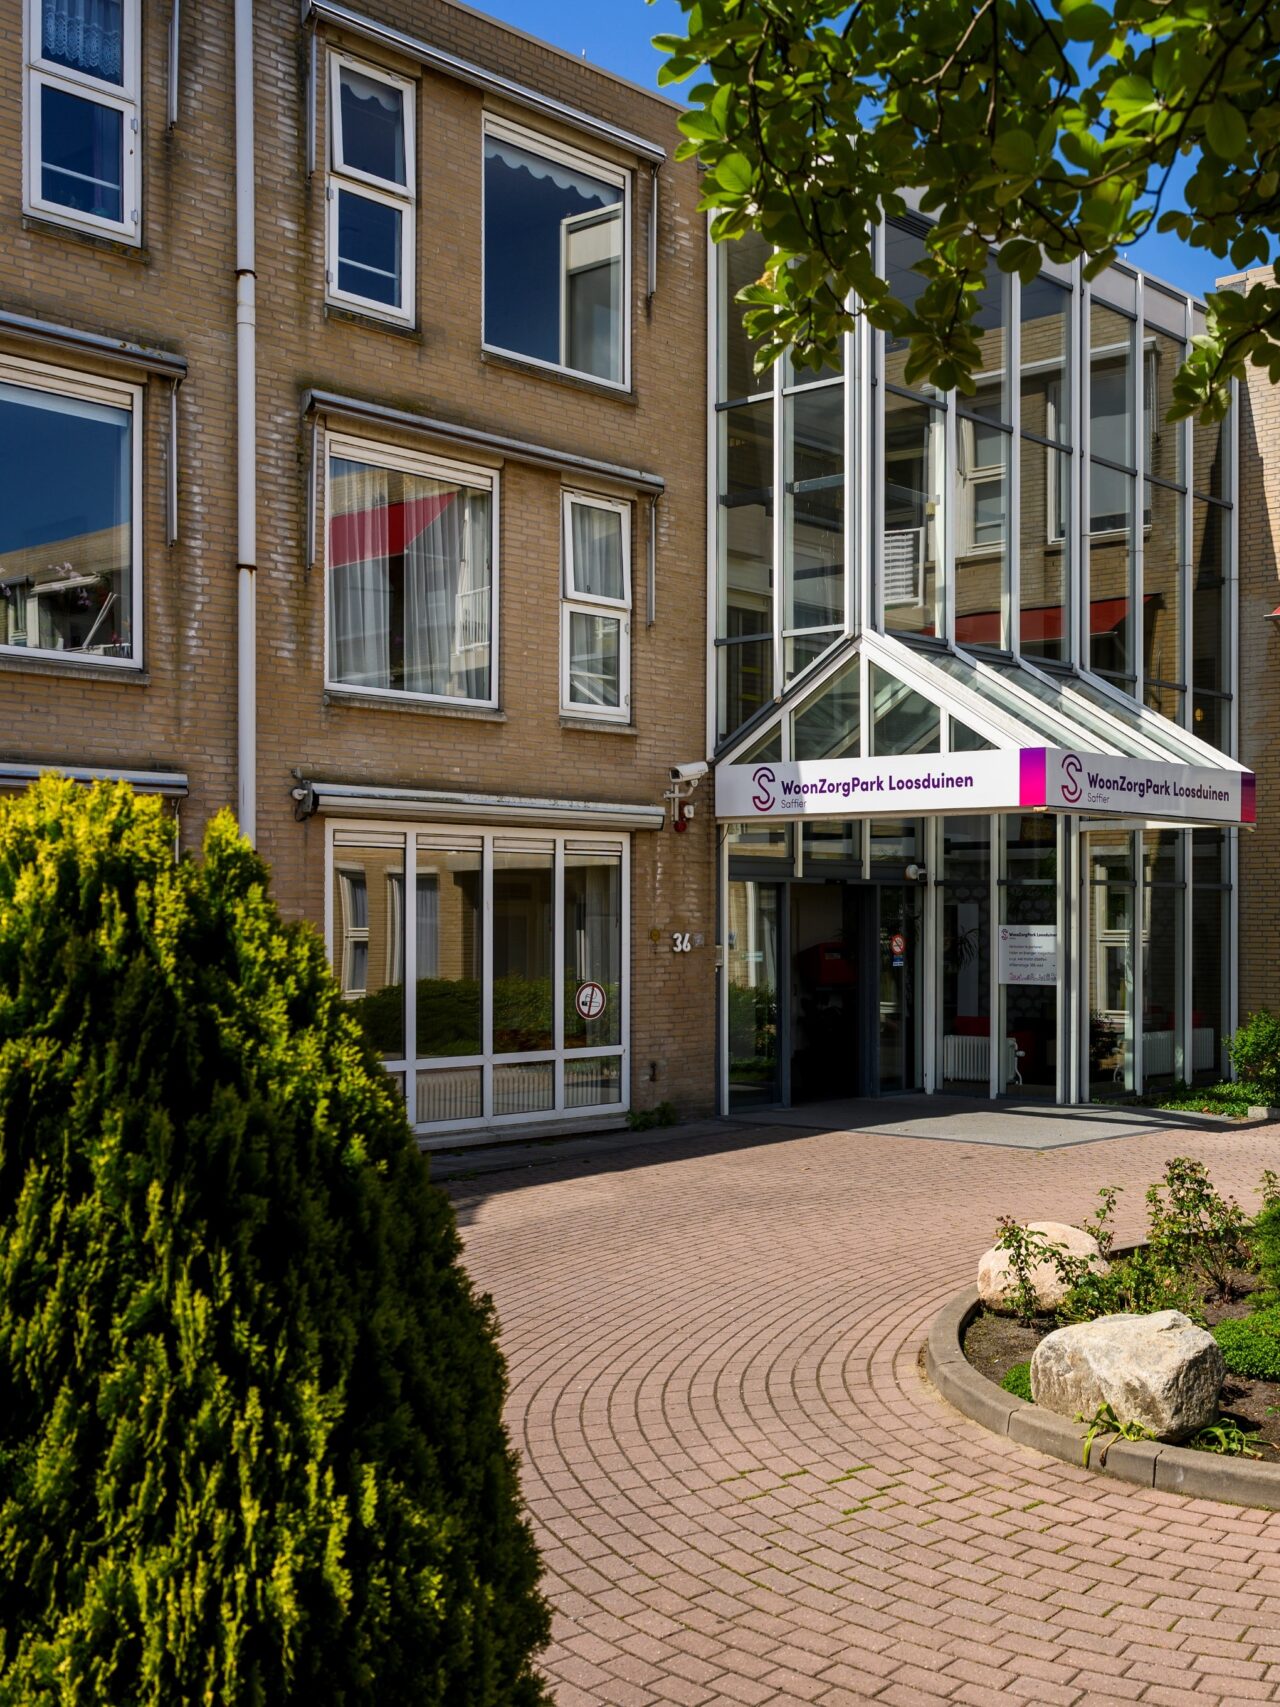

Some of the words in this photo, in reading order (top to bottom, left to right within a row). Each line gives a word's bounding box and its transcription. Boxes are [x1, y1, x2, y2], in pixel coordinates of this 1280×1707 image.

[781, 775, 884, 797] WoonZorgPark
[888, 773, 974, 791] Loosduinen
[1087, 772, 1171, 798] WoonZorgPark
[1173, 781, 1230, 802] Loosduinen
[781, 799, 807, 809] Saffier
[1087, 792, 1110, 804] Saffier
[672, 932, 692, 953] 36
